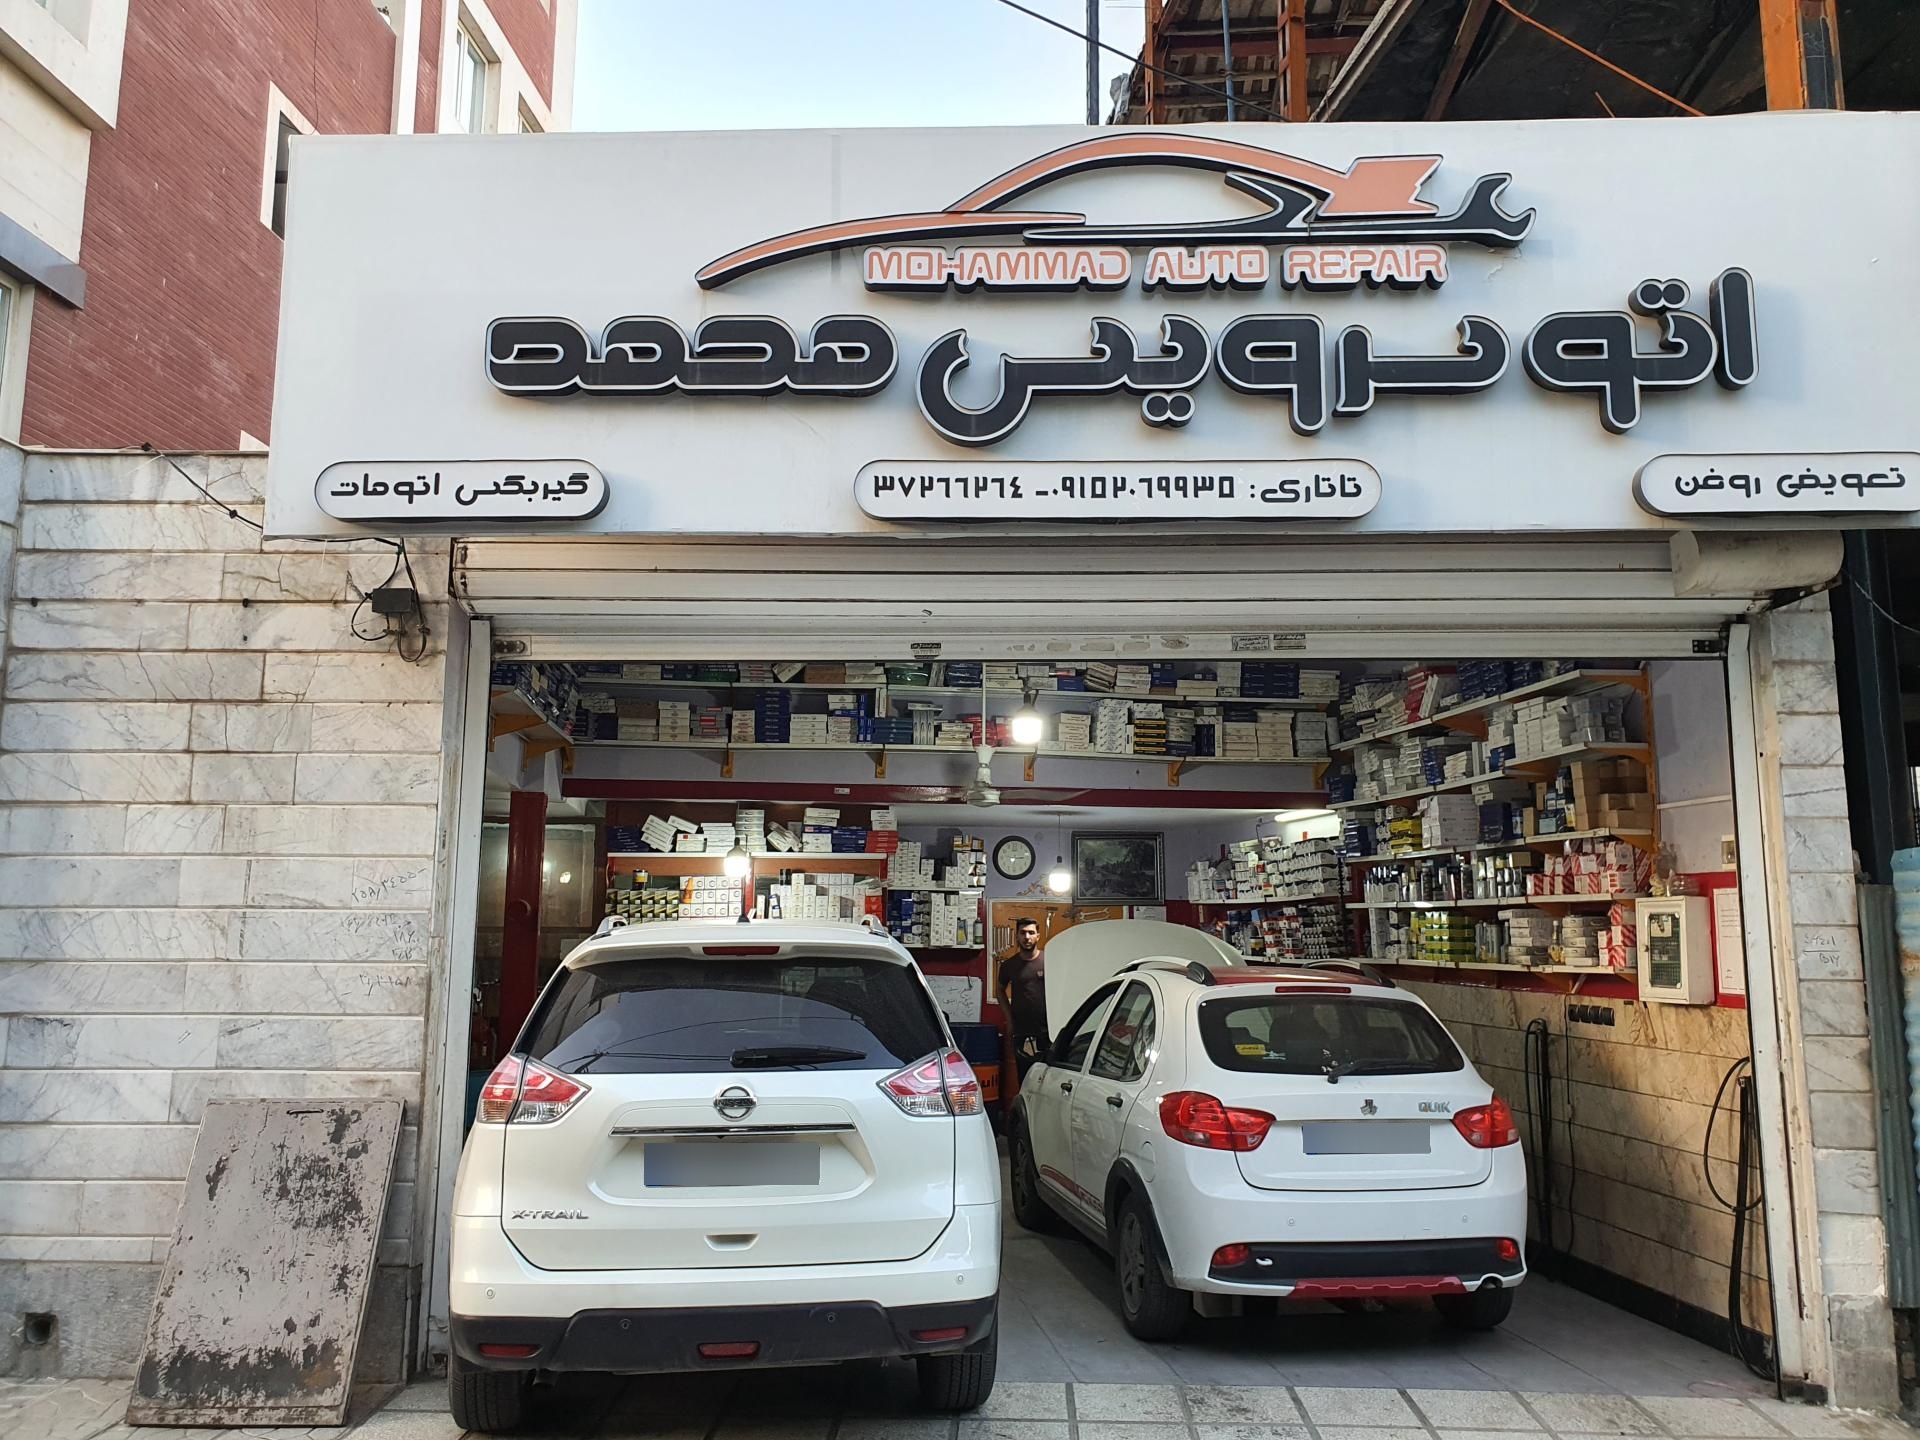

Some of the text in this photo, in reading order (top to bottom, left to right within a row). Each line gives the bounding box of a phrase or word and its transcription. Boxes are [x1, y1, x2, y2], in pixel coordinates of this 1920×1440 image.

[866, 247, 1445, 283] MOHAMMAD AUTO REPAIR
[486, 315, 899, 397] محمد
[330, 472, 590, 506] گیربکس اتومات
[1674, 467, 1906, 498] تعویض روغن
[1418, 1101, 1451, 1114] QUIK
[511, 1208, 589, 1220] X-TRAIL
